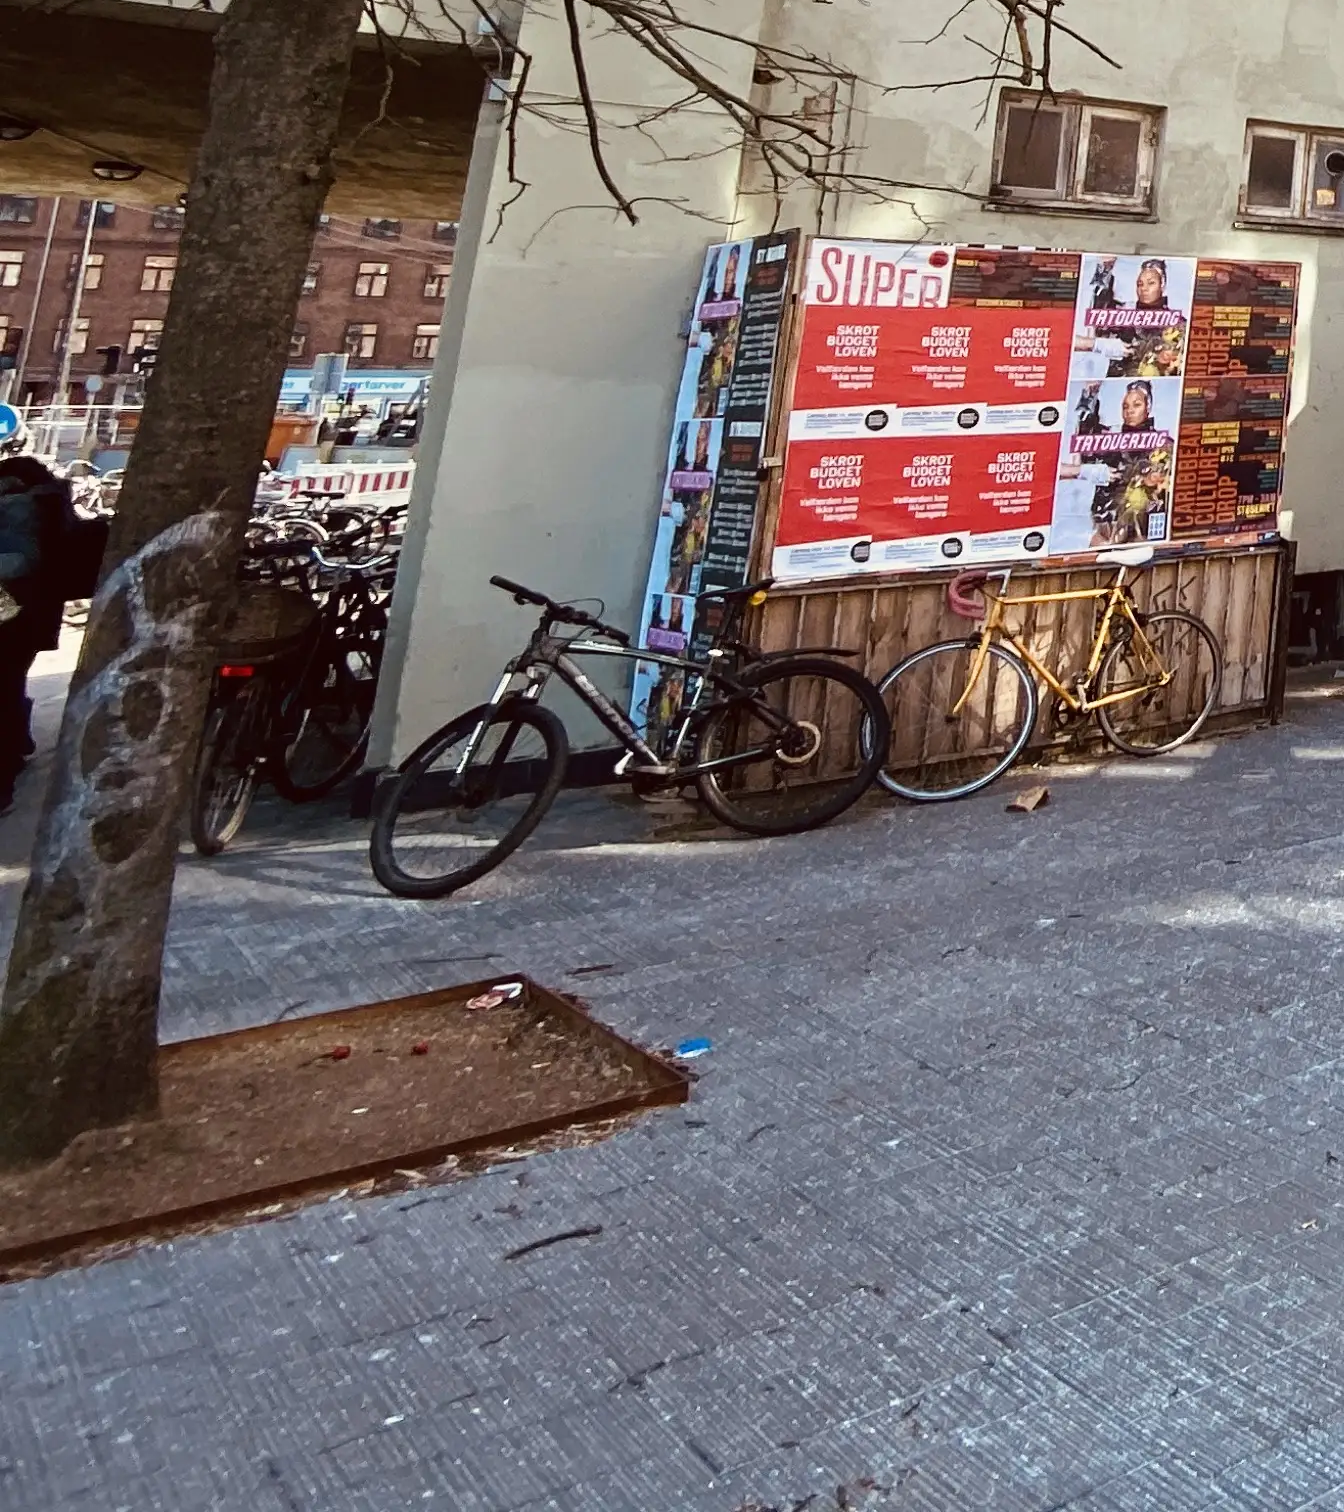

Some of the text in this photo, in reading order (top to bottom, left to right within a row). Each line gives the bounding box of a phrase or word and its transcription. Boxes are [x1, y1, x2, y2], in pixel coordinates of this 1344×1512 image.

[816, 246, 943, 307] SUPER
[836, 325, 881, 336] SKROT
[931, 326, 973, 337] SKROT
[1012, 327, 1051, 338] SKROT
[826, 335, 879, 347] BUDGET
[921, 336, 971, 348] BUDGET
[1003, 337, 1050, 348] BUDGET
[834, 346, 877, 358] LOVEN
[929, 347, 970, 358] LOVEN
[1010, 347, 1049, 358] LOVEN
[820, 455, 865, 467] SKROT
[912, 454, 955, 466] SKROT
[997, 451, 1037, 463] SKROT
[810, 465, 863, 479] BUDGET
[902, 465, 954, 478] BUDGET
[987, 462, 1036, 474] BUDGET
[995, 471, 1034, 484] LOVEN
[1172, 423, 1202, 528] CARIBBEAN
[818, 476, 862, 490] LOVEN
[910, 476, 952, 488] LOVEN
[1194, 447, 1220, 526] CULTURE
[1214, 475, 1239, 524] DROP
